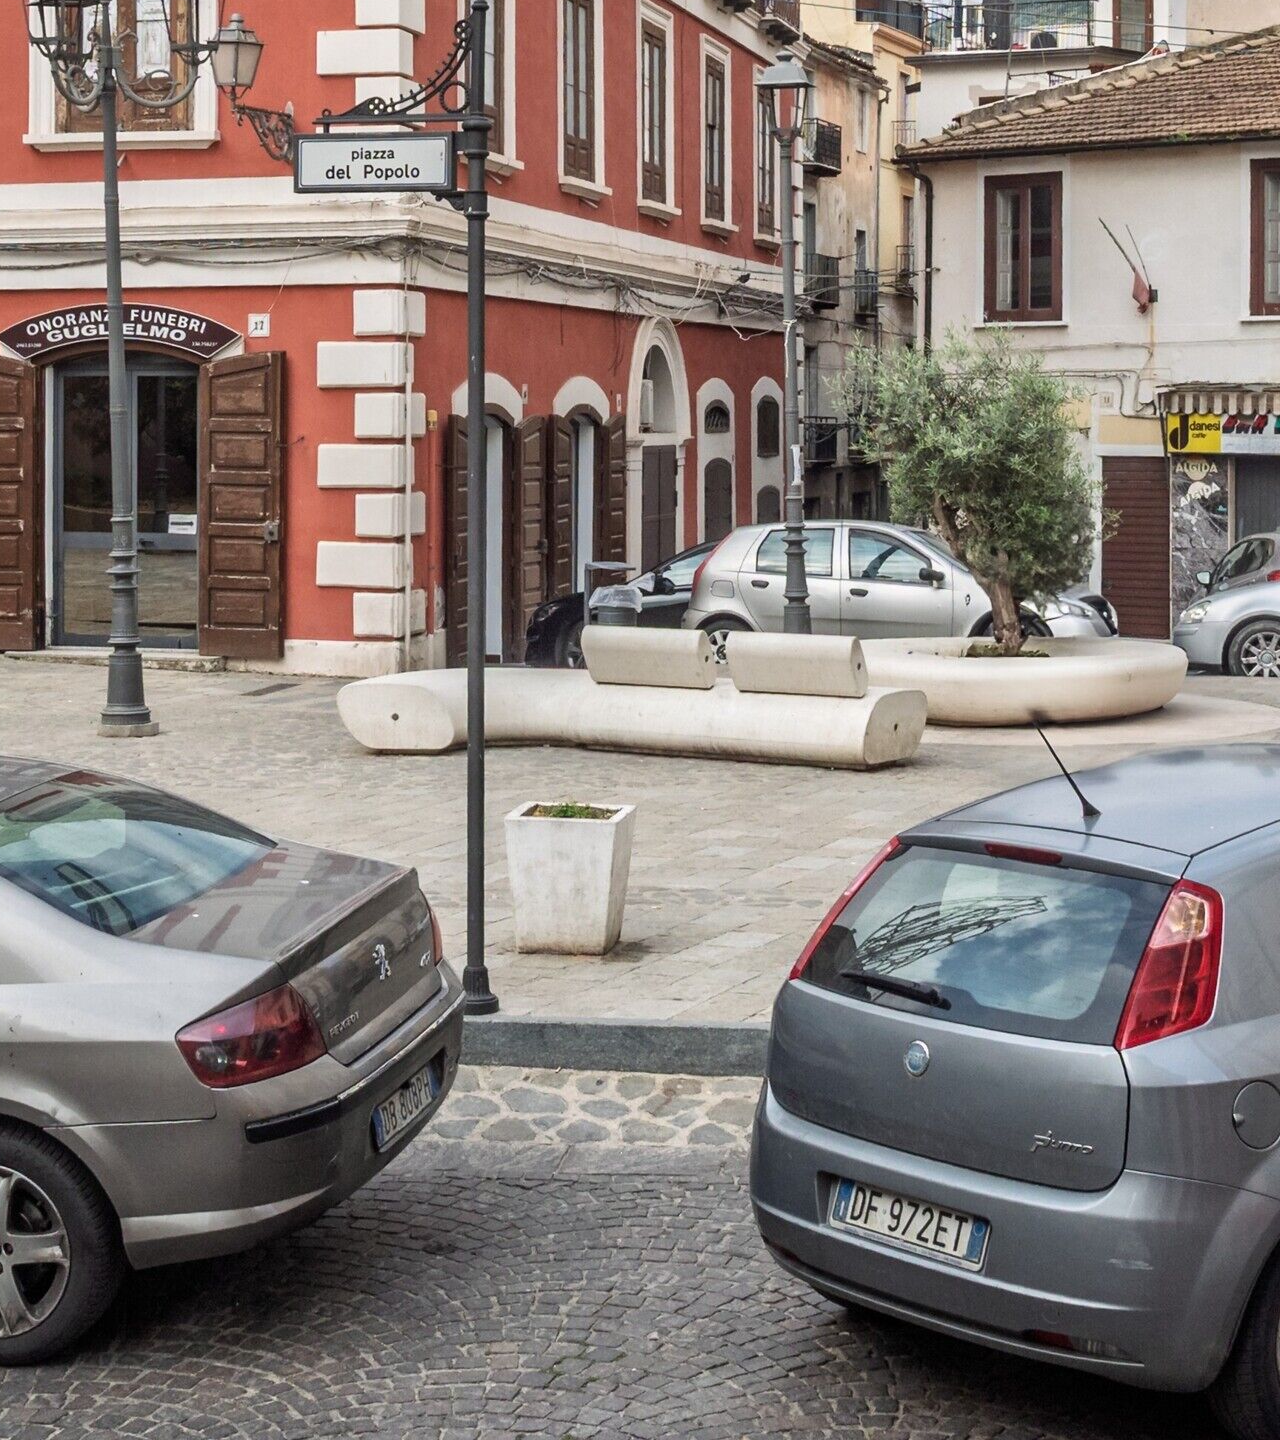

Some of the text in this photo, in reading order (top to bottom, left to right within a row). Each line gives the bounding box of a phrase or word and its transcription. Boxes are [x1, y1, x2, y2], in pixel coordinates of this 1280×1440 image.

[351, 147, 395, 162] piazza
[325, 164, 420, 181] del Popolo
[26, 309, 110, 336] ONORANZ
[130, 309, 207, 334] FUNEBRI
[46, 322, 187, 343] GUGLELMO
[1189, 420, 1221, 432] danesi
[1175, 462, 1219, 474] ALGIDA
[849, 1186, 883, 1225] DF
[886, 1197, 969, 1252] 972ET
